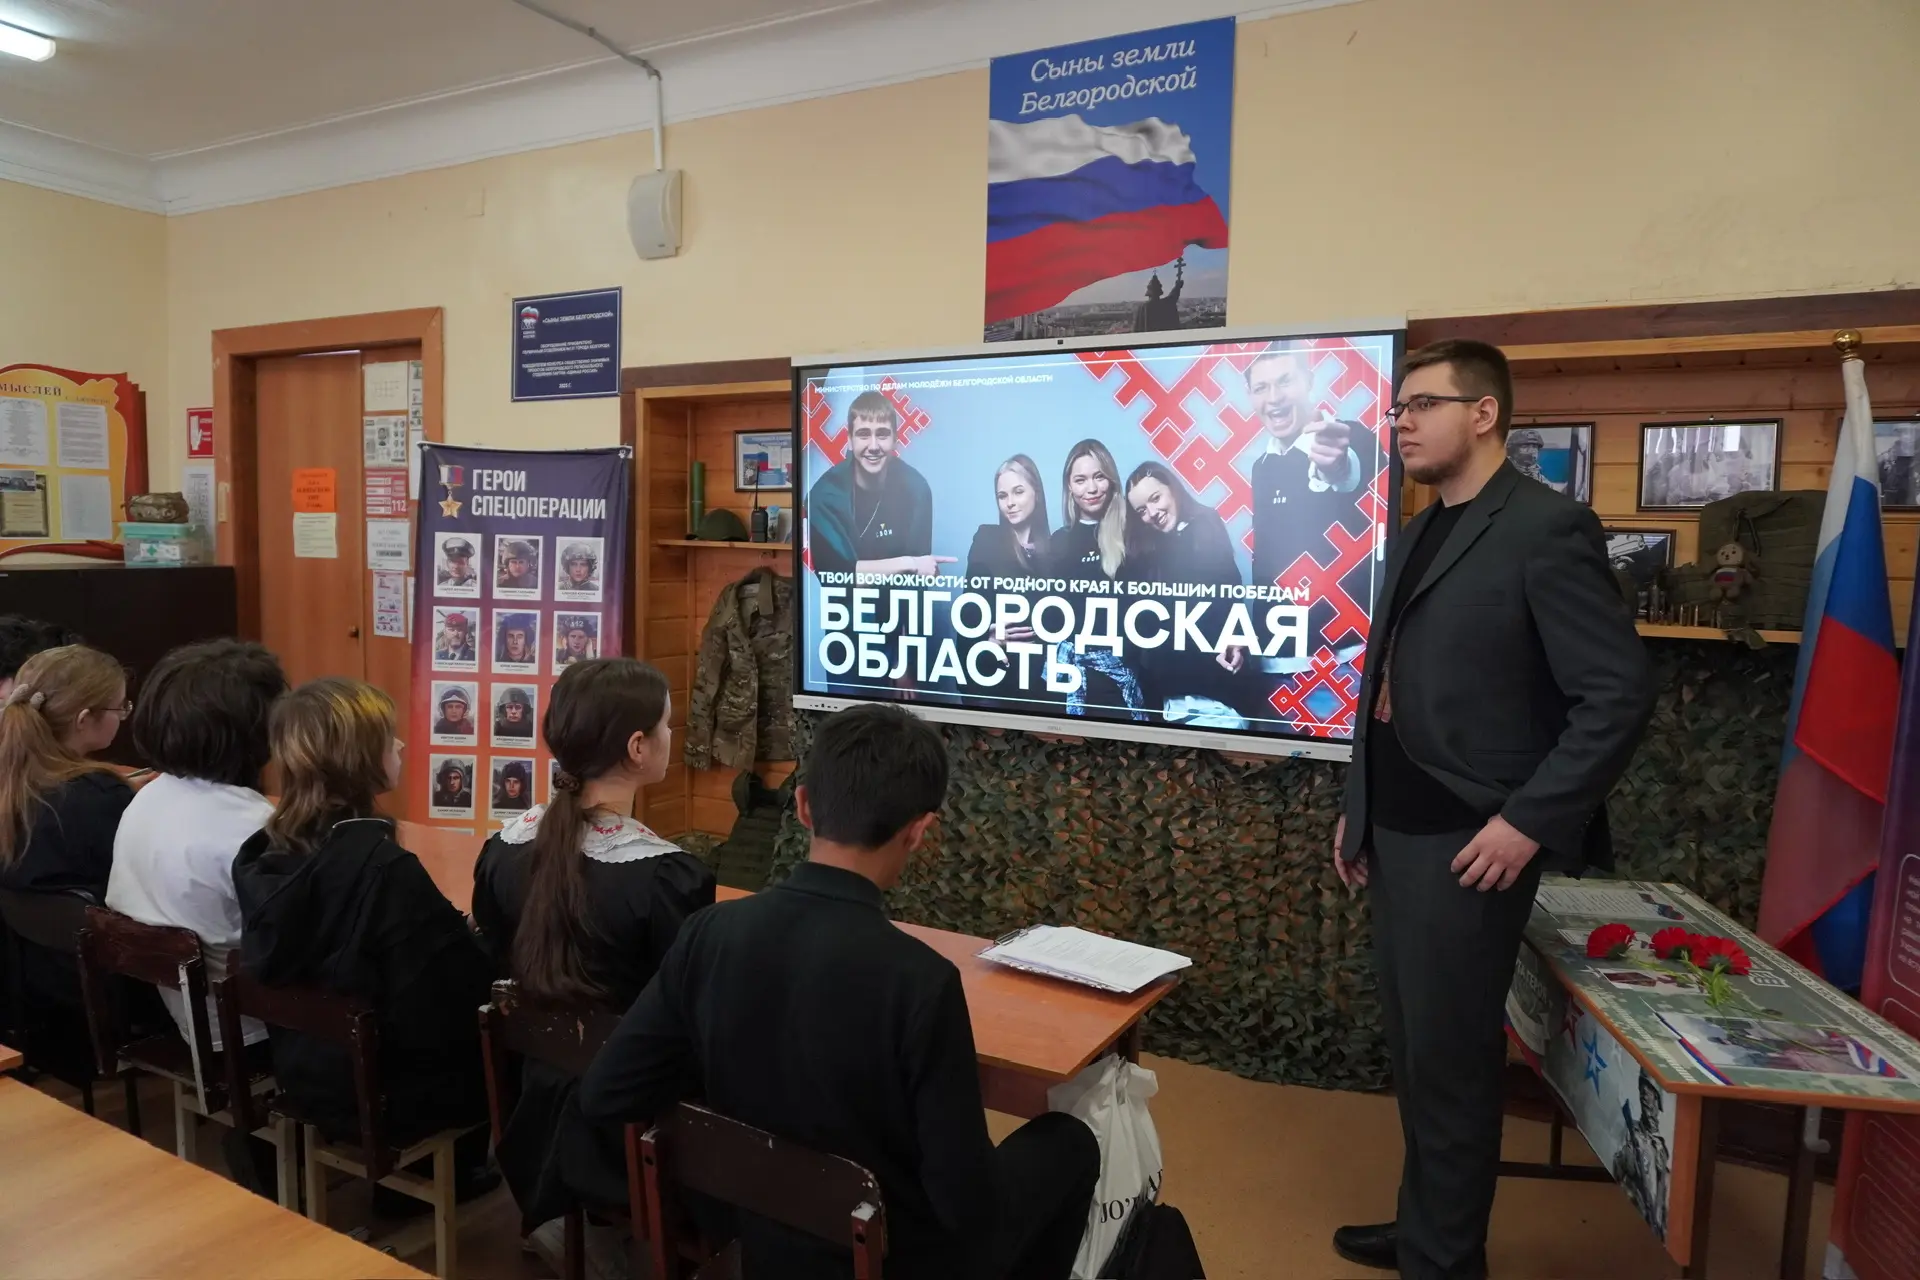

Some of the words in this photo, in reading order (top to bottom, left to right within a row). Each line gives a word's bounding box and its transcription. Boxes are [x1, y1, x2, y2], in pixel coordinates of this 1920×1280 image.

[1031, 54, 1104, 82] Сыны
[1111, 39, 1196, 69] земли
[1019, 65, 1197, 114] Белгородской
[814, 383, 869, 394] МИНИСТЕРСТВО
[870, 382, 880, 391] ПО
[882, 381, 907, 391] ДЕЛАМ
[953, 375, 1013, 387] БЕЛГОРОДСКОЙ
[1015, 374, 1053, 384] ОБЛАСТИ
[472, 469, 526, 492] ГЕРОИ
[471, 495, 606, 522] СПЕЦОПЕРАЦИИ
[819, 571, 854, 585] ТВОИ
[856, 572, 968, 588] ВОЗМОЖНОСТИ:
[970, 575, 991, 589] ОТ
[993, 576, 1066, 592] РОДНОГО
[1069, 579, 1110, 594] КРАЯ
[1113, 580, 1125, 594] К
[1127, 581, 1216, 599] БОЛЬШИМ
[1220, 584, 1310, 602] ПОБЕДАМ
[819, 586, 1309, 658] БЕЛГОРОДСКАЯ
[818, 632, 1082, 695] ОБЛАСТЬ
